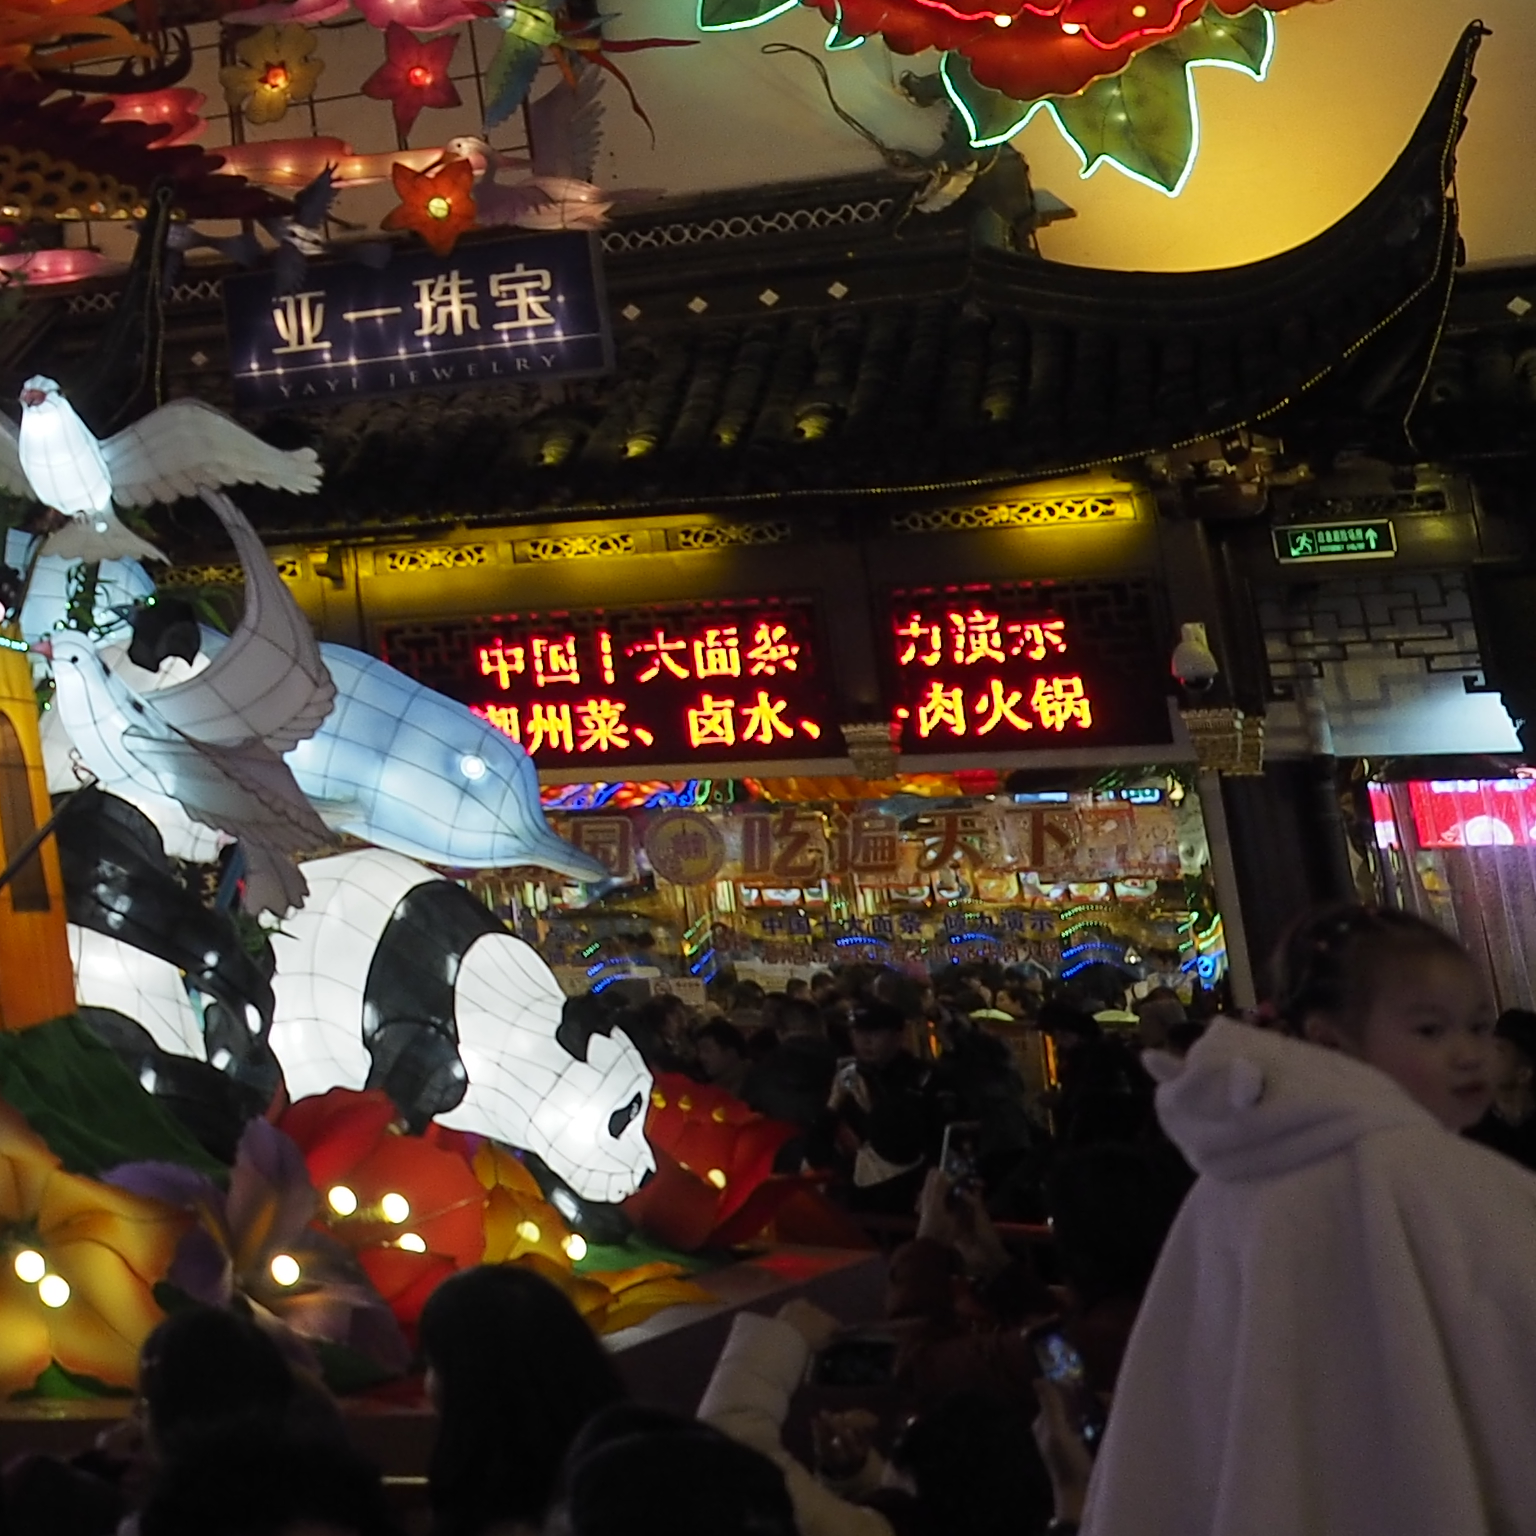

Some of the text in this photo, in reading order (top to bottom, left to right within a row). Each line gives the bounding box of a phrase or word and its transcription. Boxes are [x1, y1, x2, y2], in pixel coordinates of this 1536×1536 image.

[271, 263, 556, 355] 亚一珠宝
[279, 354, 557, 399] YAYI JEWELRY
[896, 675, 1093, 738] 肉火锅
